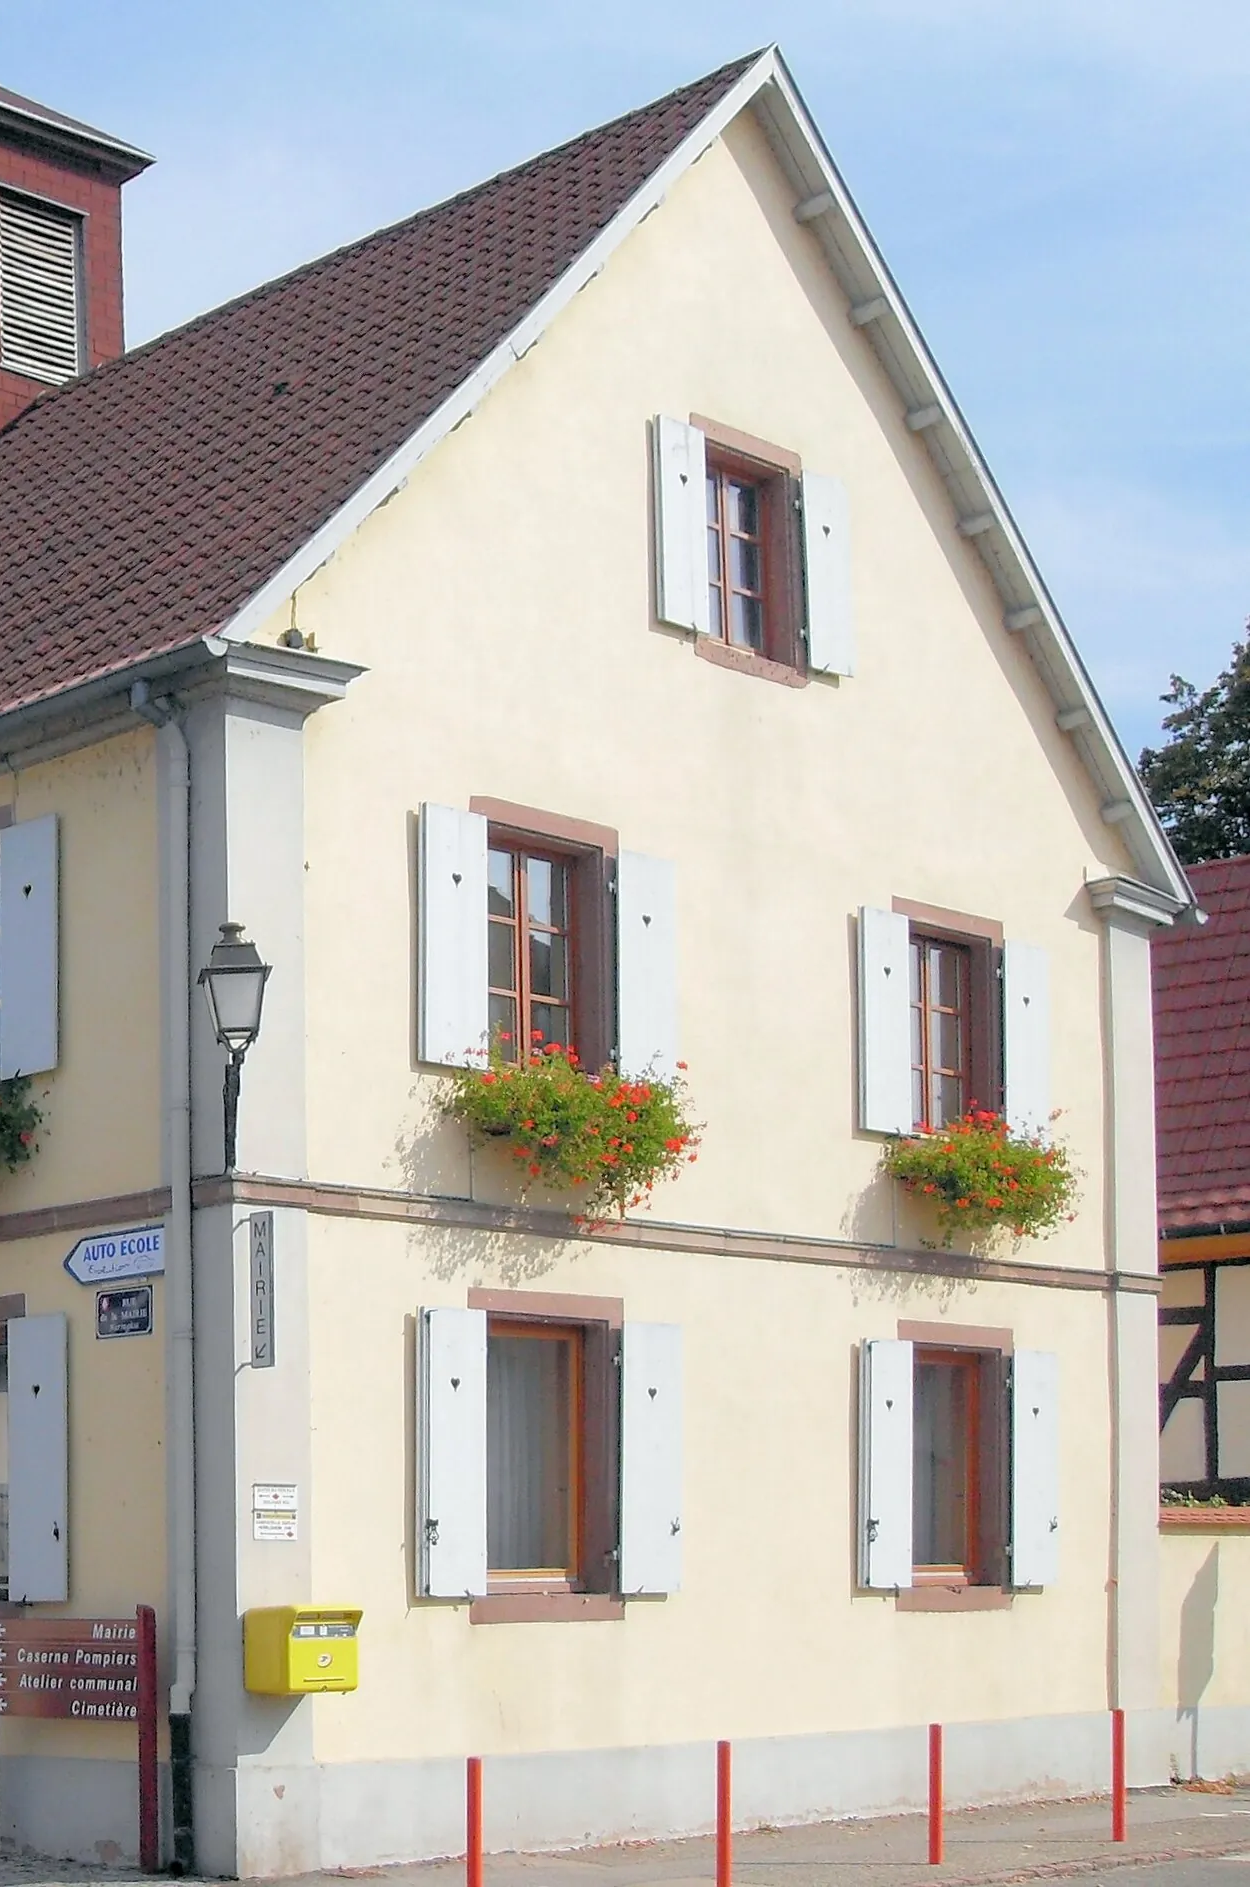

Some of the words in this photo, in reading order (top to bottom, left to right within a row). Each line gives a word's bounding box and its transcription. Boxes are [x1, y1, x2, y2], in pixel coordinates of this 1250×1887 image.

[83, 1242, 116, 1262] AUTO
[254, 1221, 266, 1334] MAIRIE
[121, 1308, 147, 1318] MAIRIE
[92, 1624, 136, 1640] Mairie
[17, 1648, 69, 1665] Caserne
[75, 1649, 137, 1668] Pompiers
[19, 1674, 63, 1690] Atelier
[69, 1676, 138, 1691] communal
[71, 1700, 138, 1717] Cimetière
